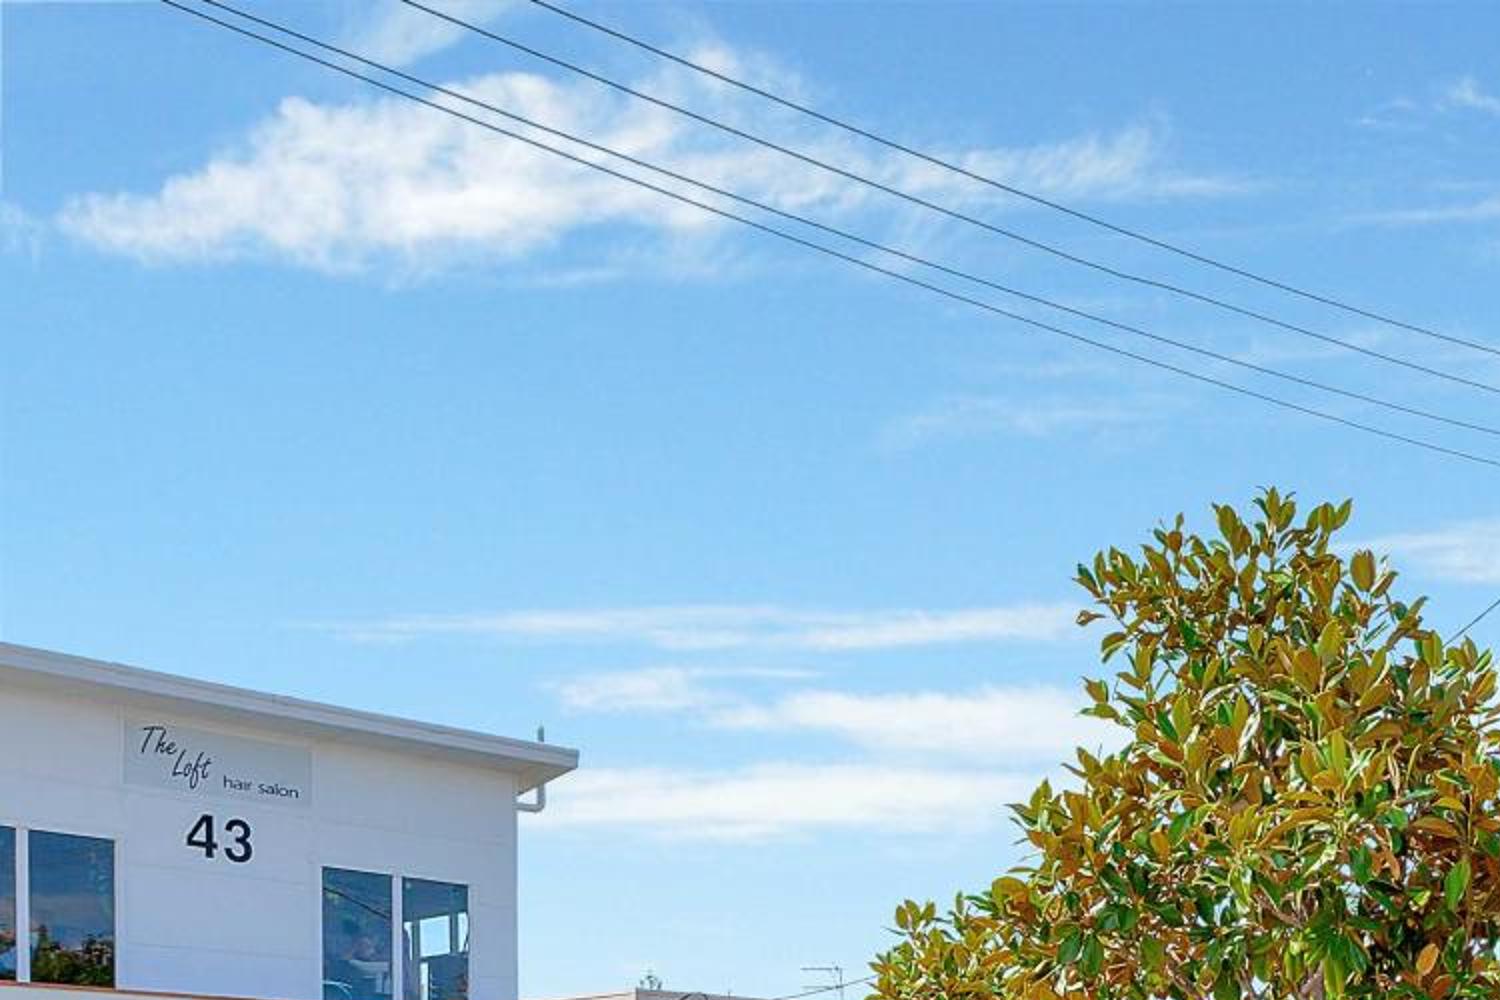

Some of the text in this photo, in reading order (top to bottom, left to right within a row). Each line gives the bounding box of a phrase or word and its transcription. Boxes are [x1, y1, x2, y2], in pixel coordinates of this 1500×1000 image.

[138, 724, 178, 756] The
[171, 749, 213, 790] Loft
[222, 774, 300, 799] hair salon
[185, 812, 254, 864] 43
